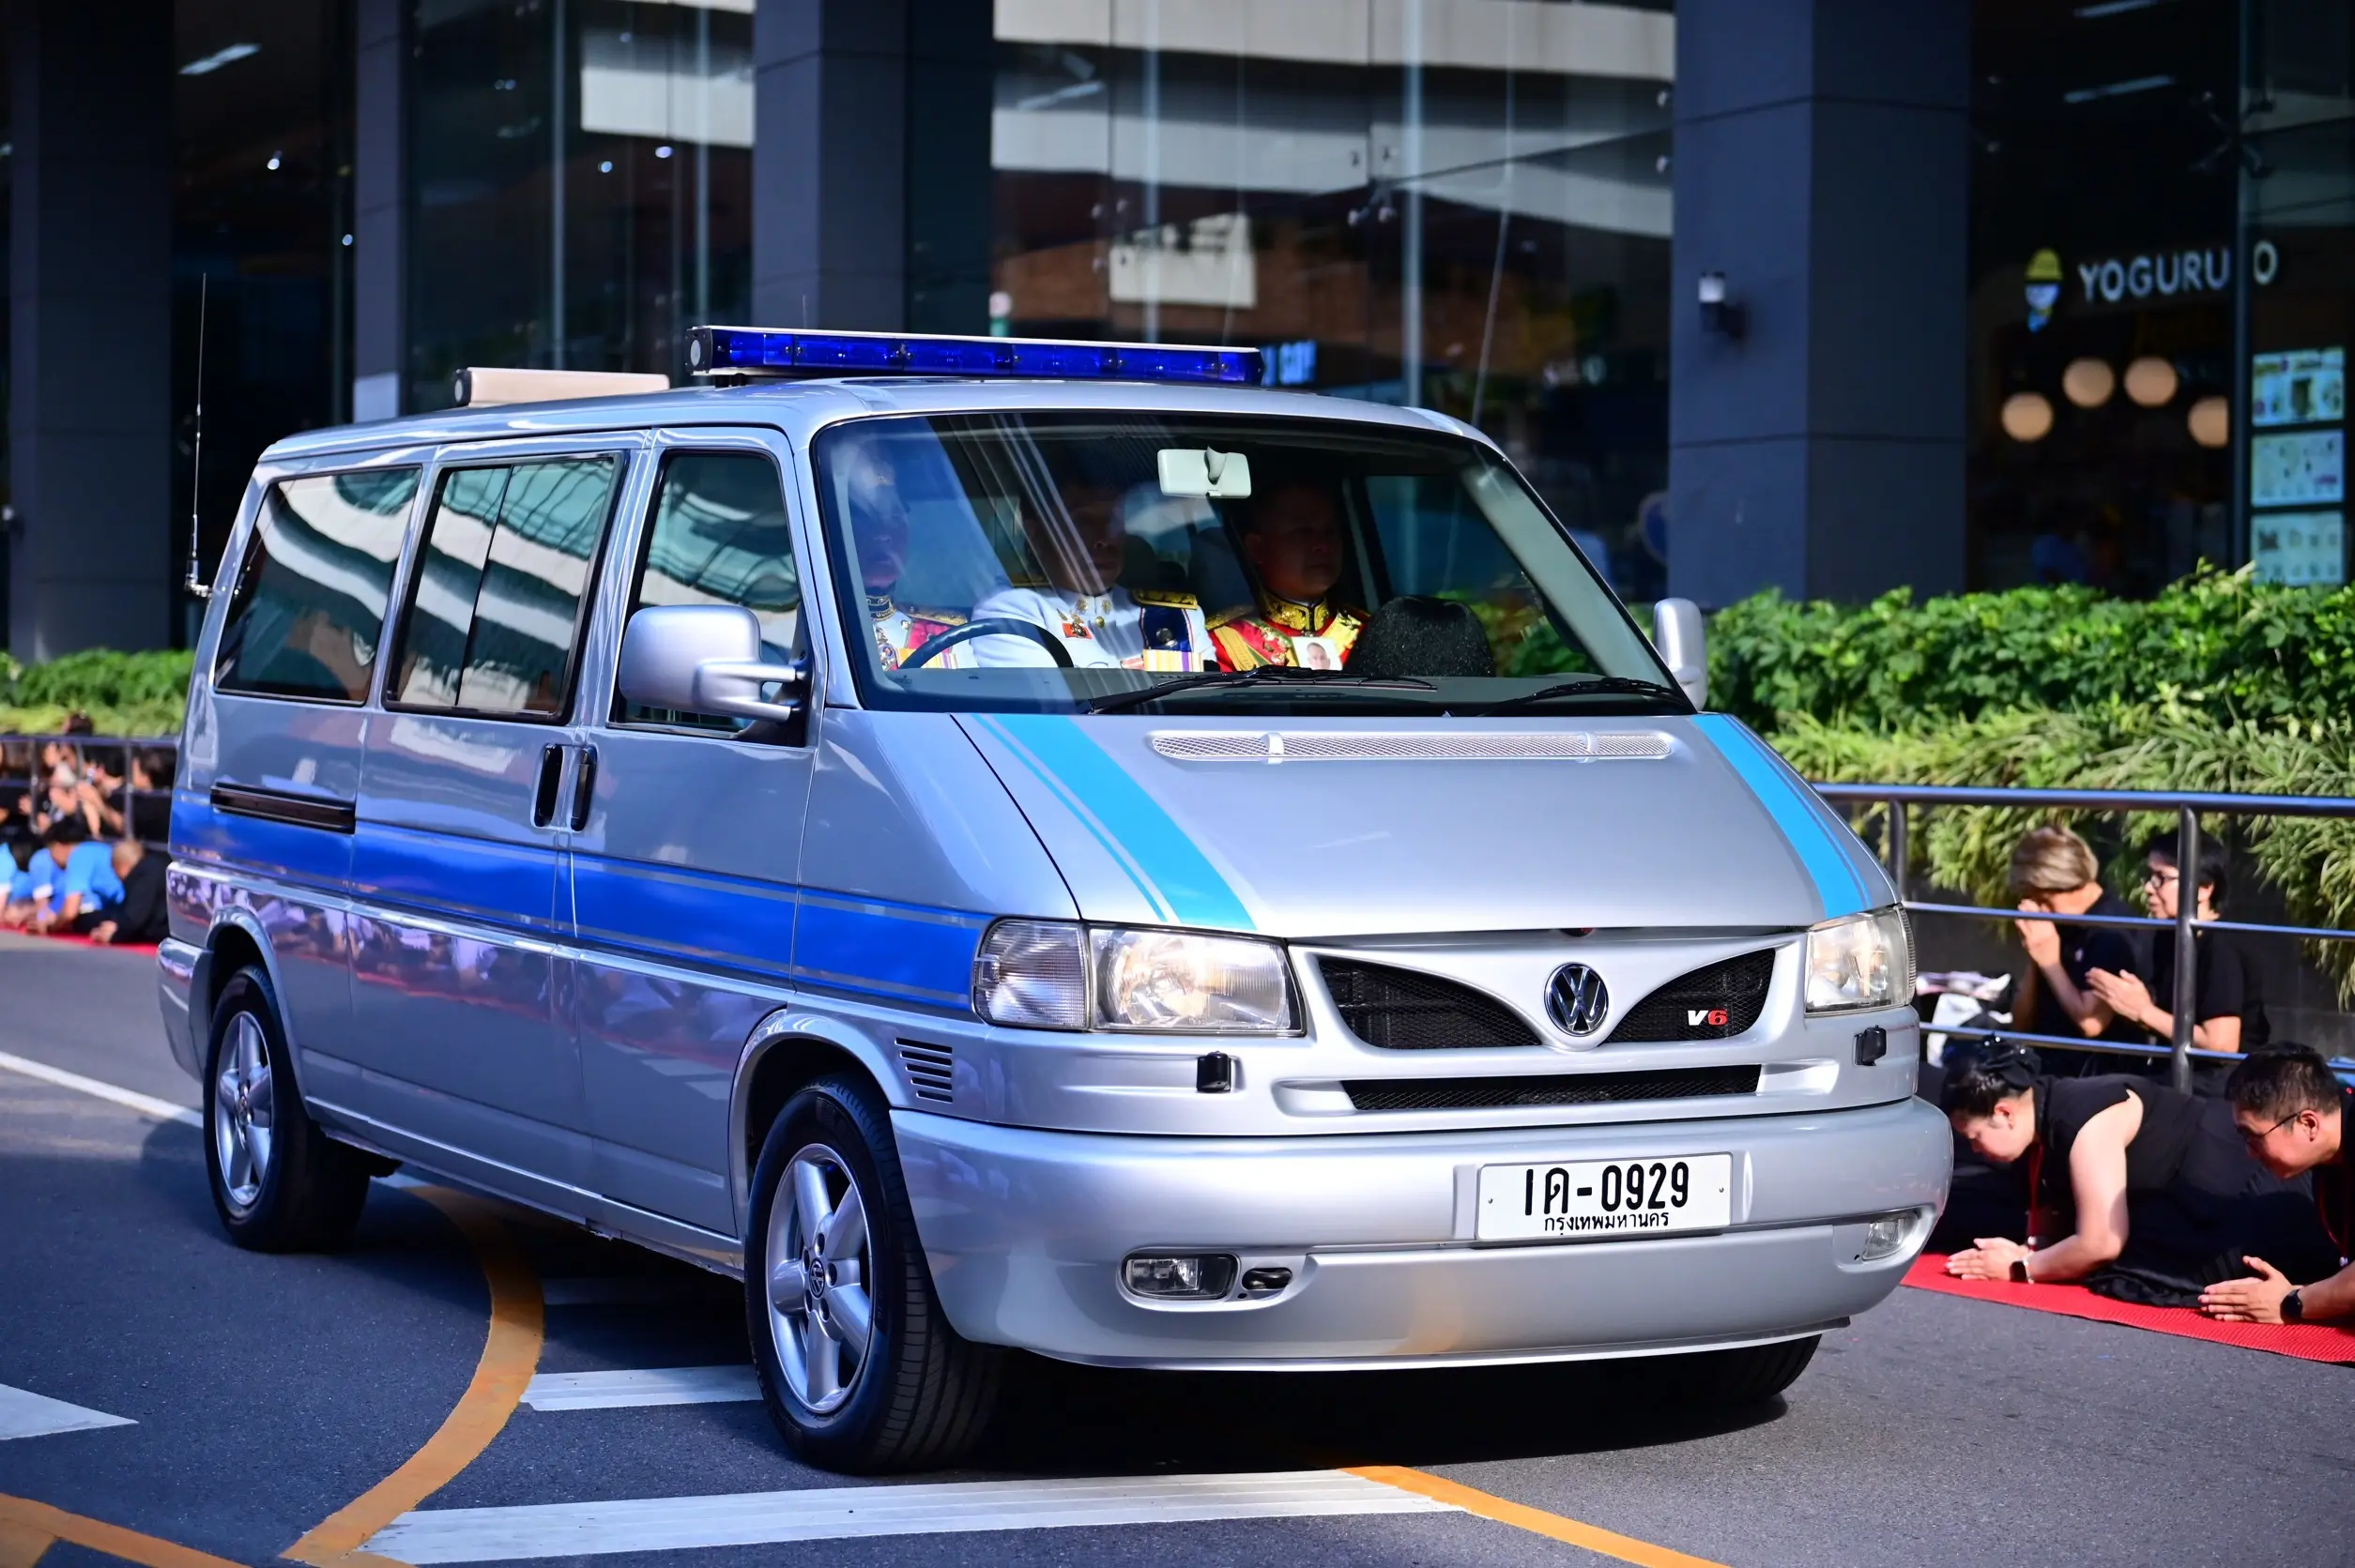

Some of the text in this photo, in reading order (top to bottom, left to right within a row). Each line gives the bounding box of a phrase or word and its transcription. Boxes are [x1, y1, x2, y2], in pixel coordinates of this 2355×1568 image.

[2077, 240, 2279, 303] YOGURUO
[1688, 1010, 1728, 1026] V6
[1544, 1211, 1669, 1236] กรุงเทพมหานคร
